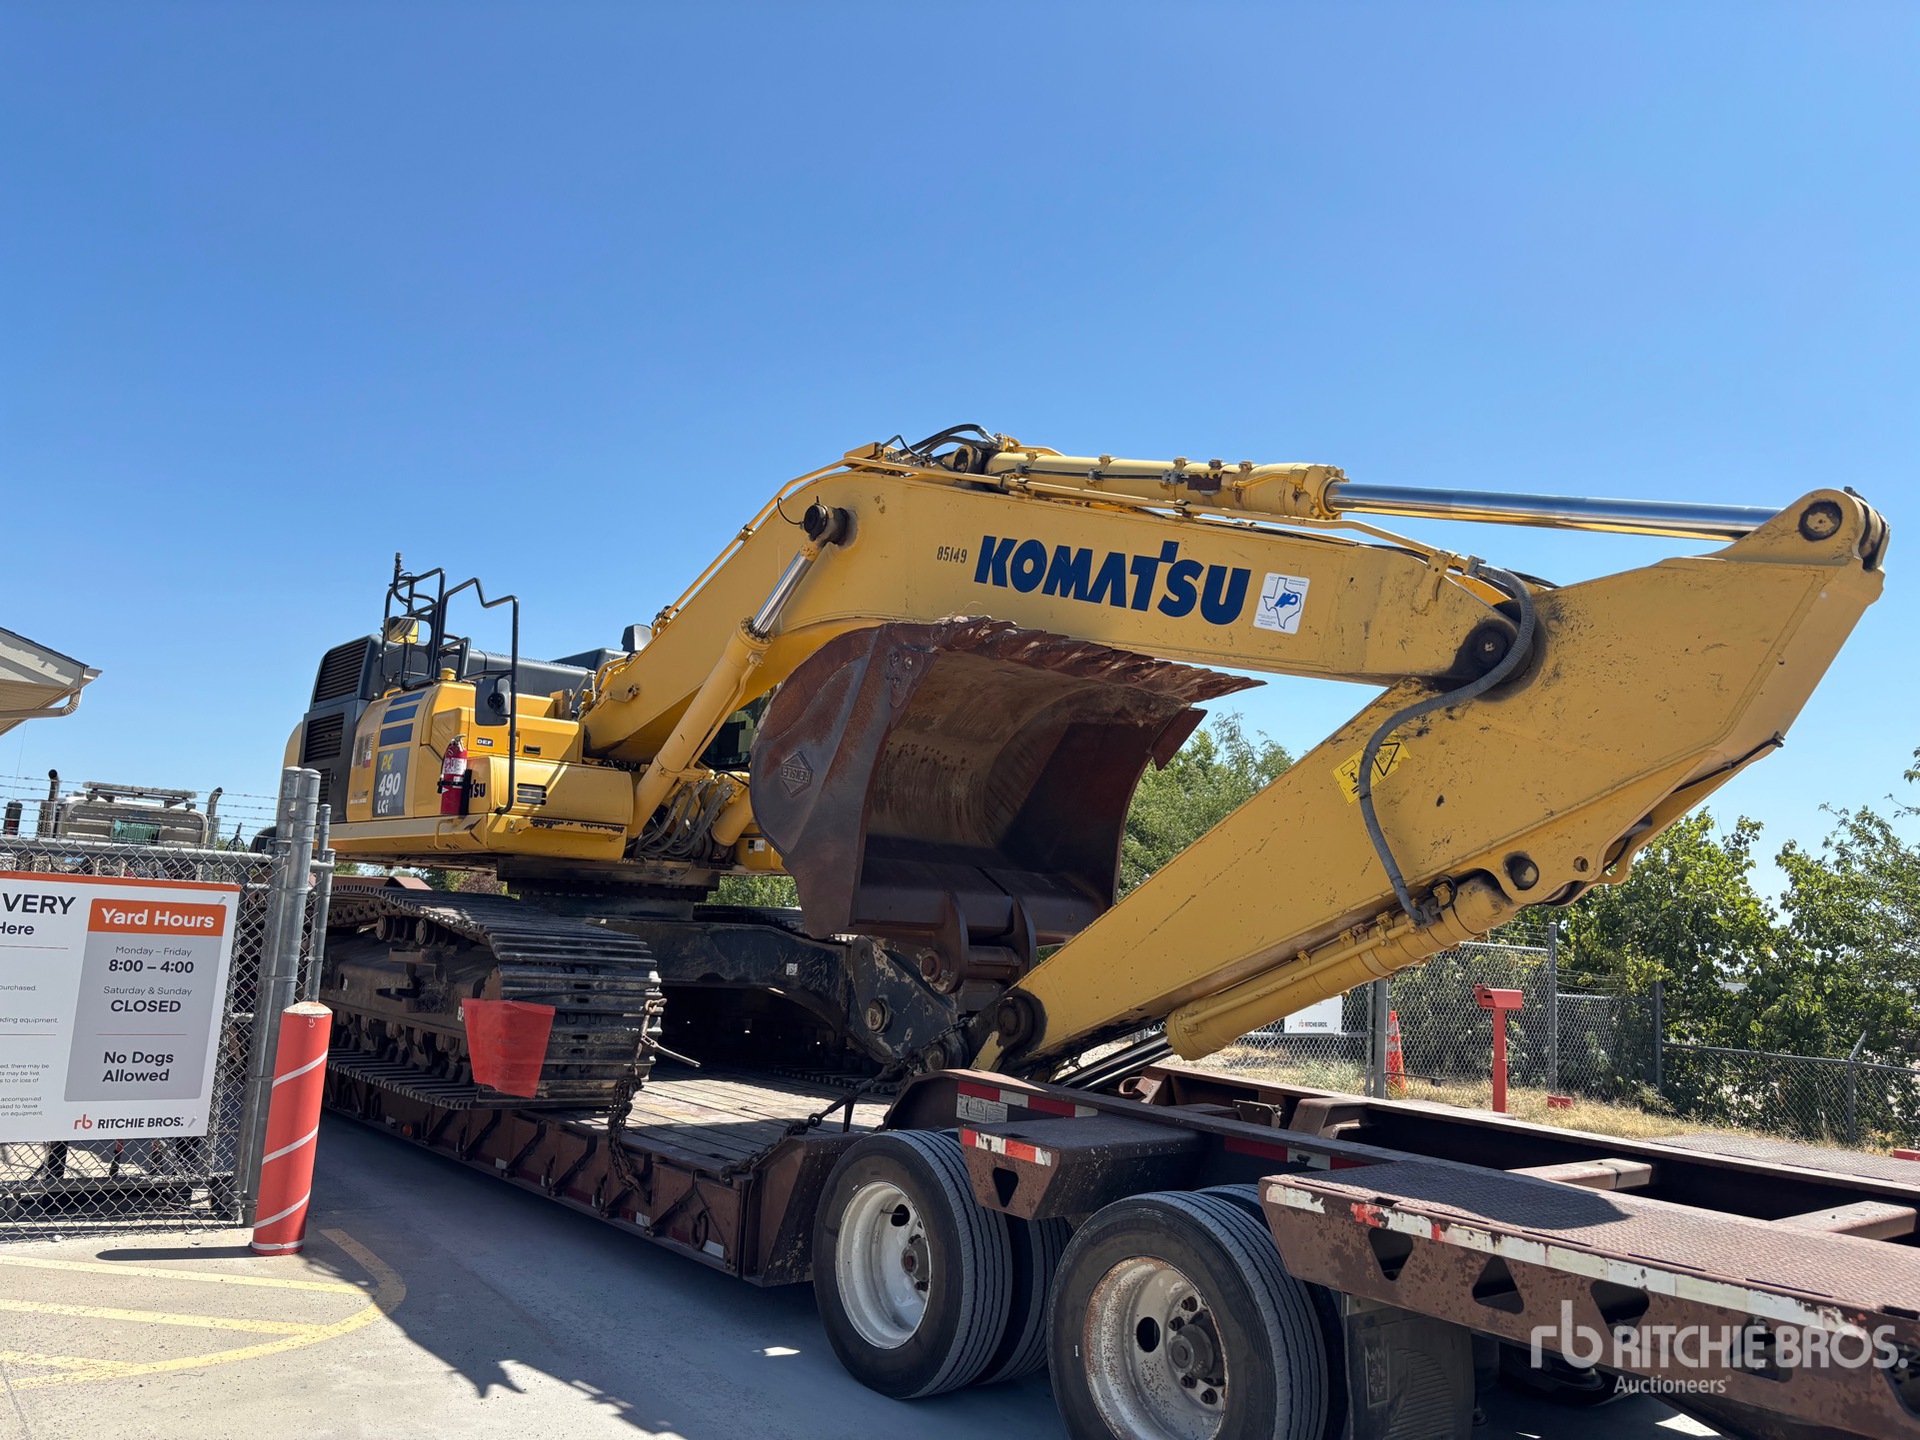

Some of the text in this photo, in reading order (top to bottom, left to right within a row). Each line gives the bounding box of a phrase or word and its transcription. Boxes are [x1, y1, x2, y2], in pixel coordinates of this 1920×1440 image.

[936, 535, 1252, 626] 85149 KOMATSU
[477, 738, 493, 746] DEF
[381, 753, 394, 771] PC
[378, 772, 401, 797] 490
[101, 907, 215, 928] Yard Hours
[115, 946, 154, 957] Monday
[163, 947, 193, 957] Friday
[108, 959, 144, 972] 8:00
[160, 961, 194, 973] 4:00
[103, 986, 193, 997] Saturday & Sunday
[110, 999, 182, 1013] CLOSED
[103, 1051, 174, 1067] No Dogs
[101, 1068, 170, 1082] Allowed
[73, 1113, 93, 1130] rb
[97, 1117, 145, 1129] RITCHIE
